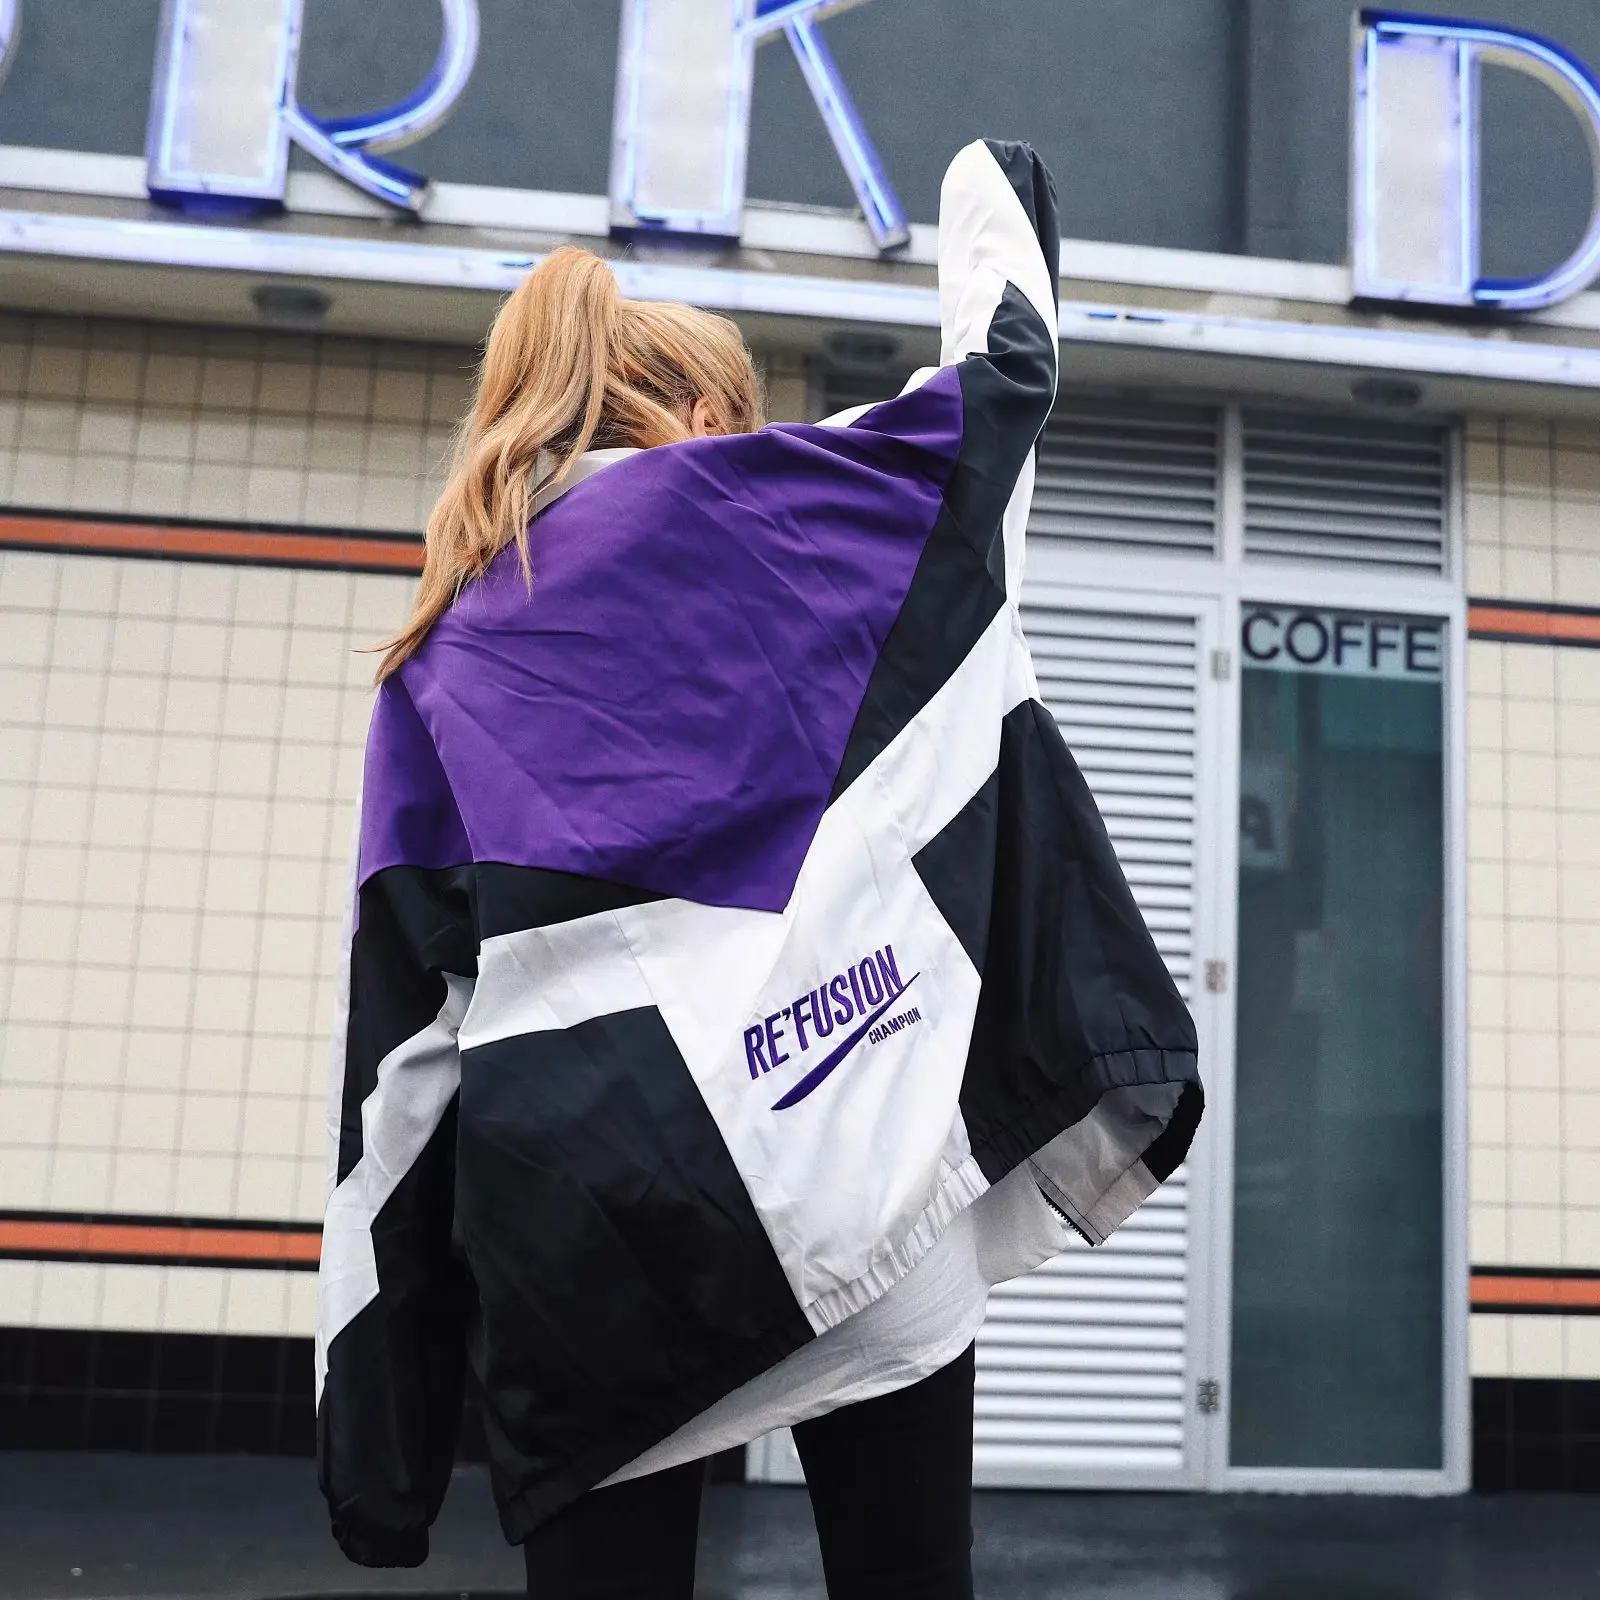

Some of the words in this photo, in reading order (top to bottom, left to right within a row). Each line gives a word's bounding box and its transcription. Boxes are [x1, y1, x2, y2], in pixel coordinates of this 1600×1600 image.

[0, 0, 911, 249] RK
[1242, 611, 1442, 673] COFFE
[868, 1006, 922, 1045] CHAMPION
